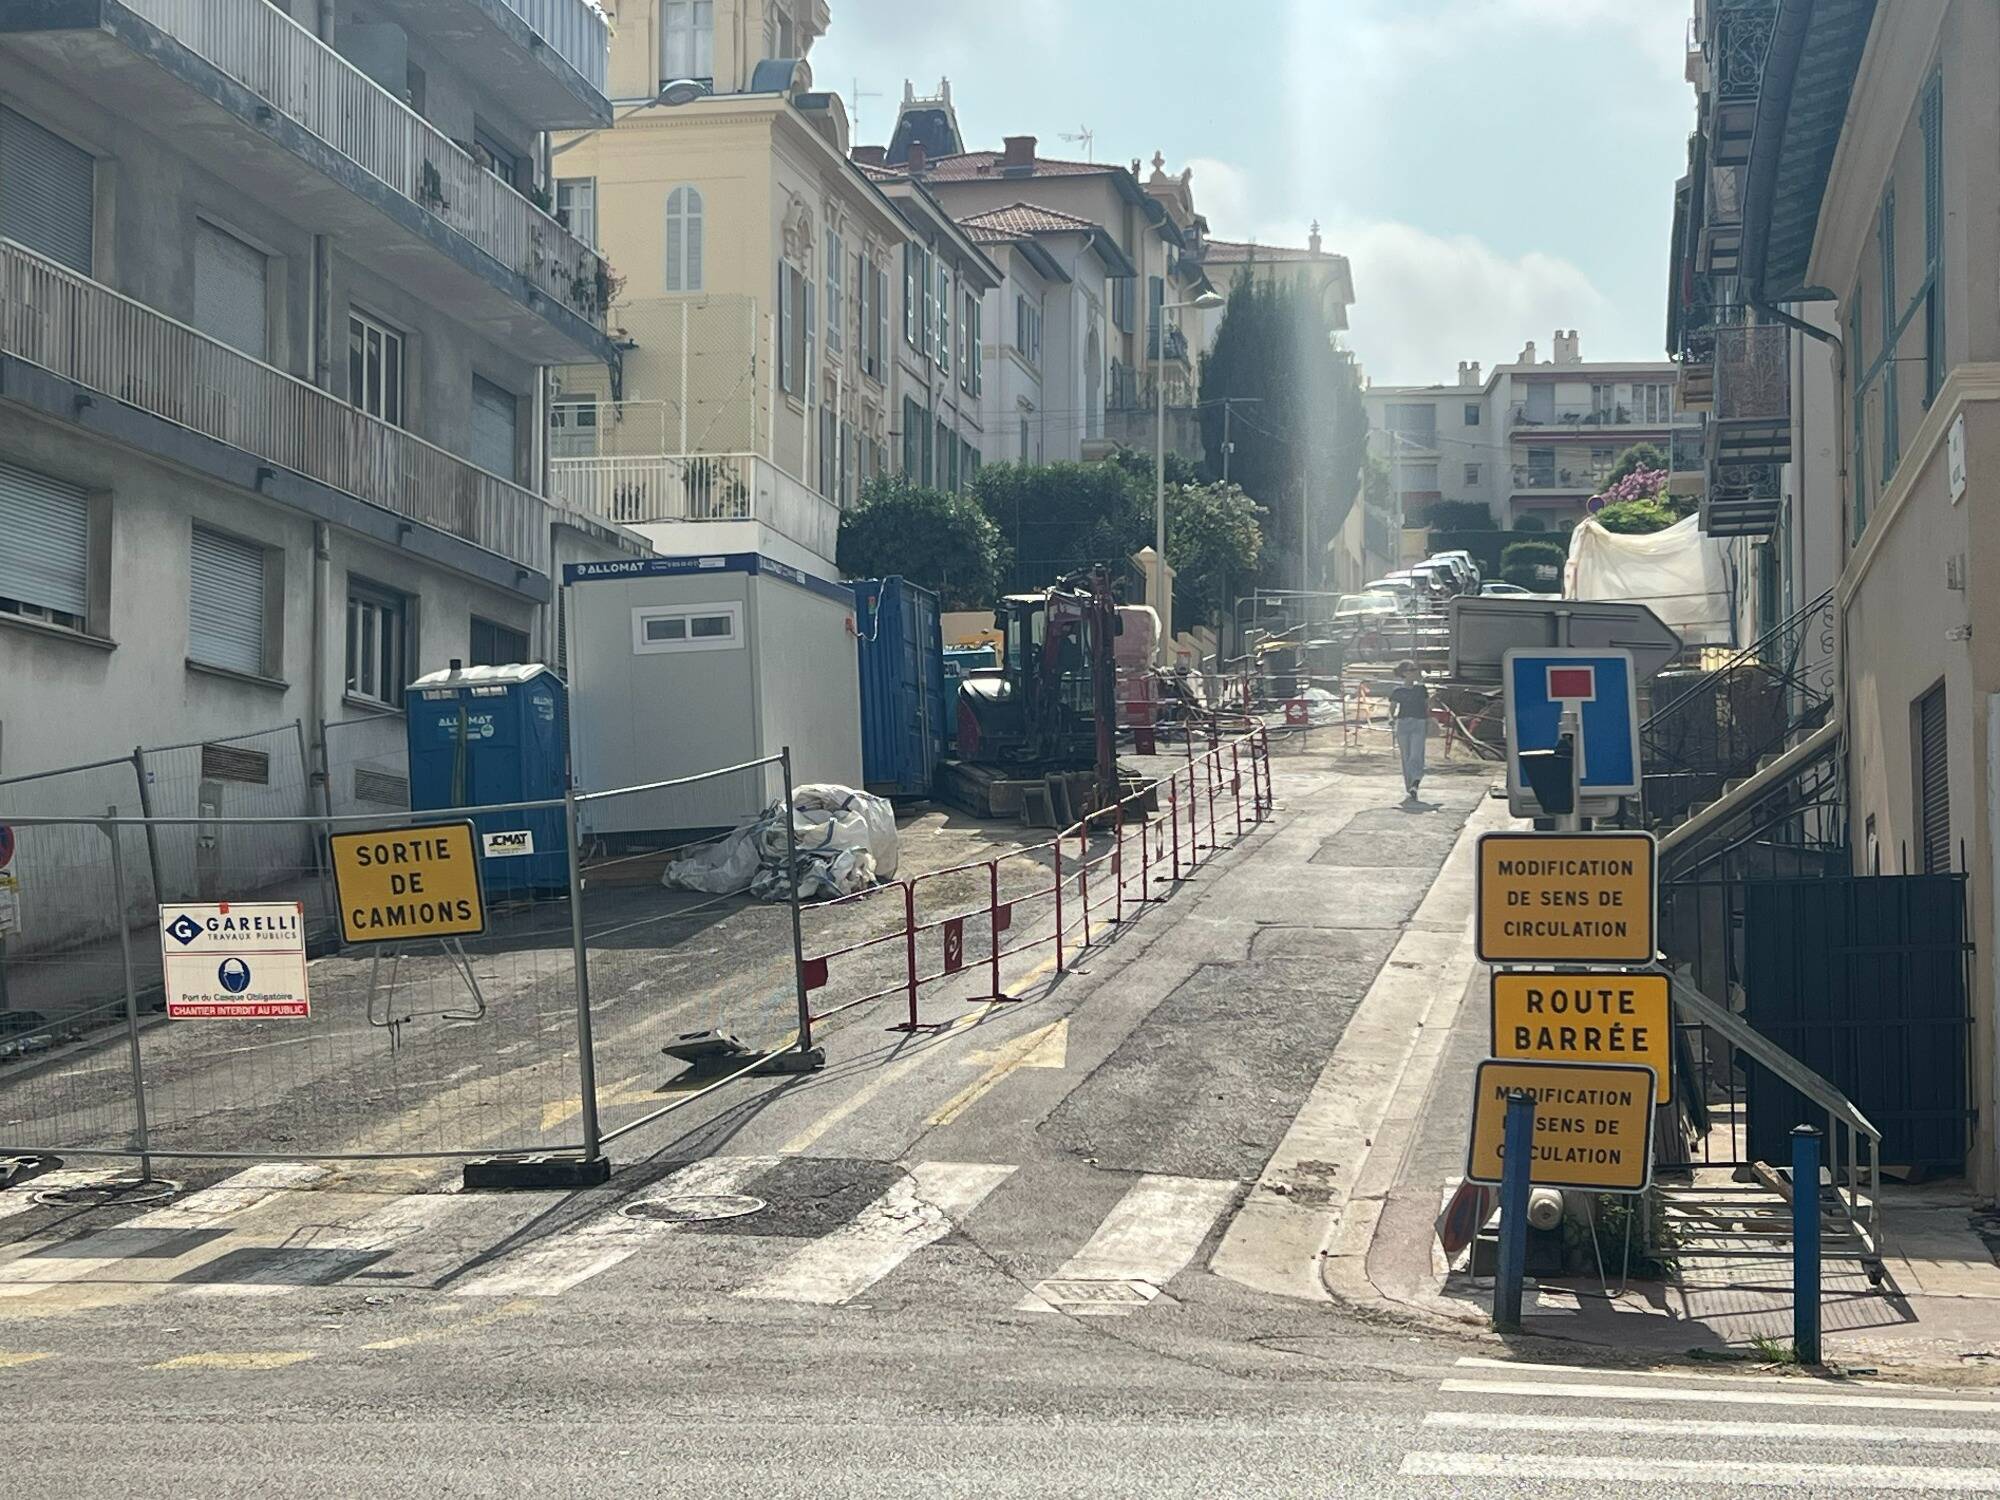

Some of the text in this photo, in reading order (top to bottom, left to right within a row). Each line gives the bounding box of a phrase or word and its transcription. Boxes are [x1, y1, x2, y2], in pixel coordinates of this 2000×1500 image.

[587, 562, 645, 575] ALLOMAT
[438, 715, 493, 726] ALLMAT
[357, 839, 451, 866] SORTIE
[1498, 861, 1633, 876] MODIFICATION
[391, 873, 424, 895] DE
[1508, 891, 1623, 906] DE SENS DE
[352, 900, 472, 929] CAMIONS
[206, 916, 295, 931] GARELLI
[1504, 921, 1627, 937] CIRCULATION
[207, 931, 297, 941] TRAVAUX PUBLICS
[182, 993, 200, 1001] Port
[213, 993, 245, 1003] Casque
[1527, 990, 1635, 1014] ROUTE
[173, 1005, 304, 1016] CHANTIER INTERDIT AU PUBLIC
[1515, 1022, 1648, 1051] BARRÉE
[1536, 1117, 1619, 1135] SENS DE
[1496, 1144, 1621, 1165] CCULATION
